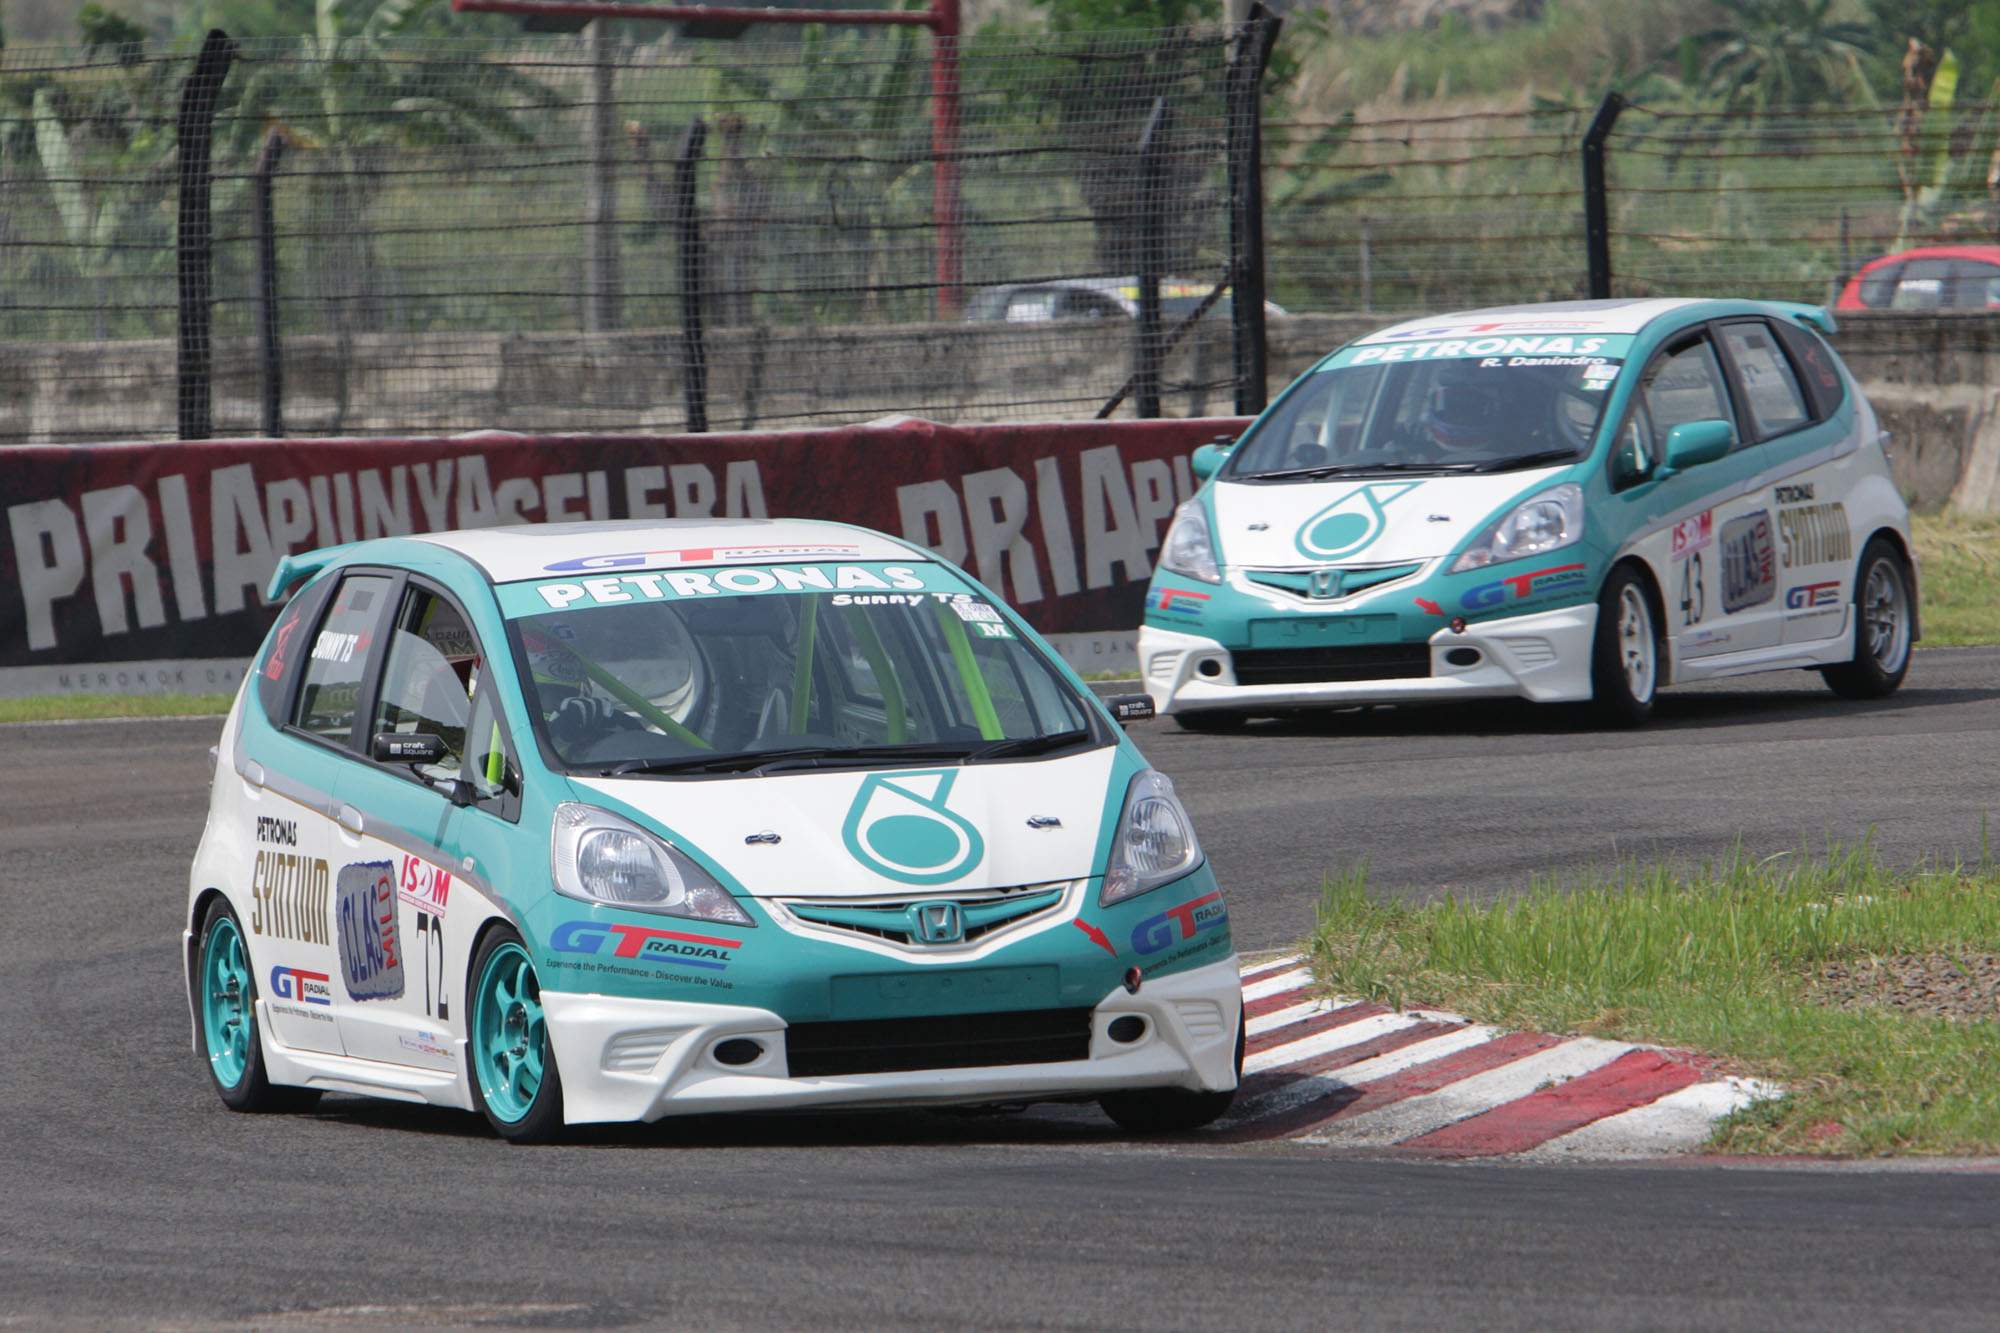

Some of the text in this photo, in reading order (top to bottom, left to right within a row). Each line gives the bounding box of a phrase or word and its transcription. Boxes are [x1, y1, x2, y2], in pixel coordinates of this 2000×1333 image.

[1350, 337, 1607, 365] PETRONAS
[1480, 355, 1608, 367] R. Danindro
[8, 463, 290, 651] PRIA
[536, 566, 925, 609] PETRONAS
[831, 593, 973, 607] Sunny TS
[1460, 564, 1585, 609] GT
[1786, 580, 1841, 609] GT
[59, 669, 184, 688] MEROKOK
[257, 816, 297, 847] PETRONAS
[252, 850, 329, 946] SYNTIUM
[550, 920, 742, 960] GT RADIAL
[1131, 890, 1222, 956] GT
[271, 965, 330, 1002] GT RADIAL
[416, 912, 448, 1020] 72
[583, 962, 596, 971] the
[597, 963, 650, 977] Performance
[656, 970, 693, 984] Discover
[710, 978, 734, 989] Value
